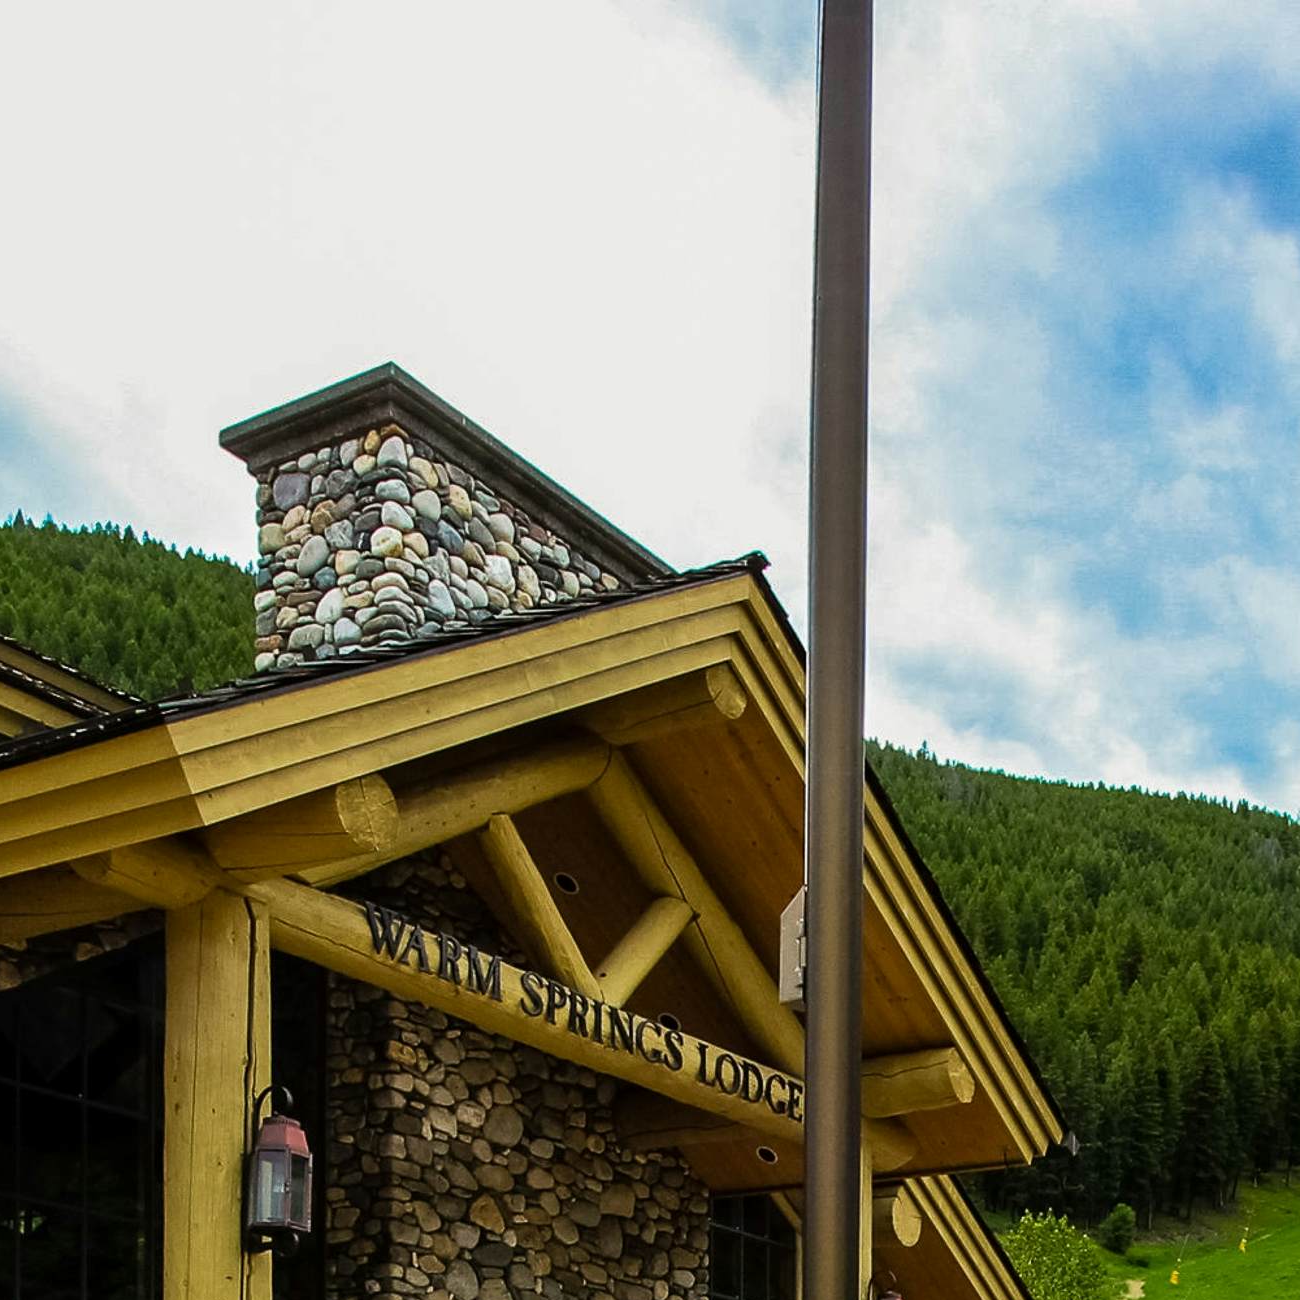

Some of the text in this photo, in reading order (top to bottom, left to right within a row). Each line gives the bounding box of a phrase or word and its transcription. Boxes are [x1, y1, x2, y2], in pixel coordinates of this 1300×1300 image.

[364, 900, 803, 1123] WARM SPRINGS LODGE
